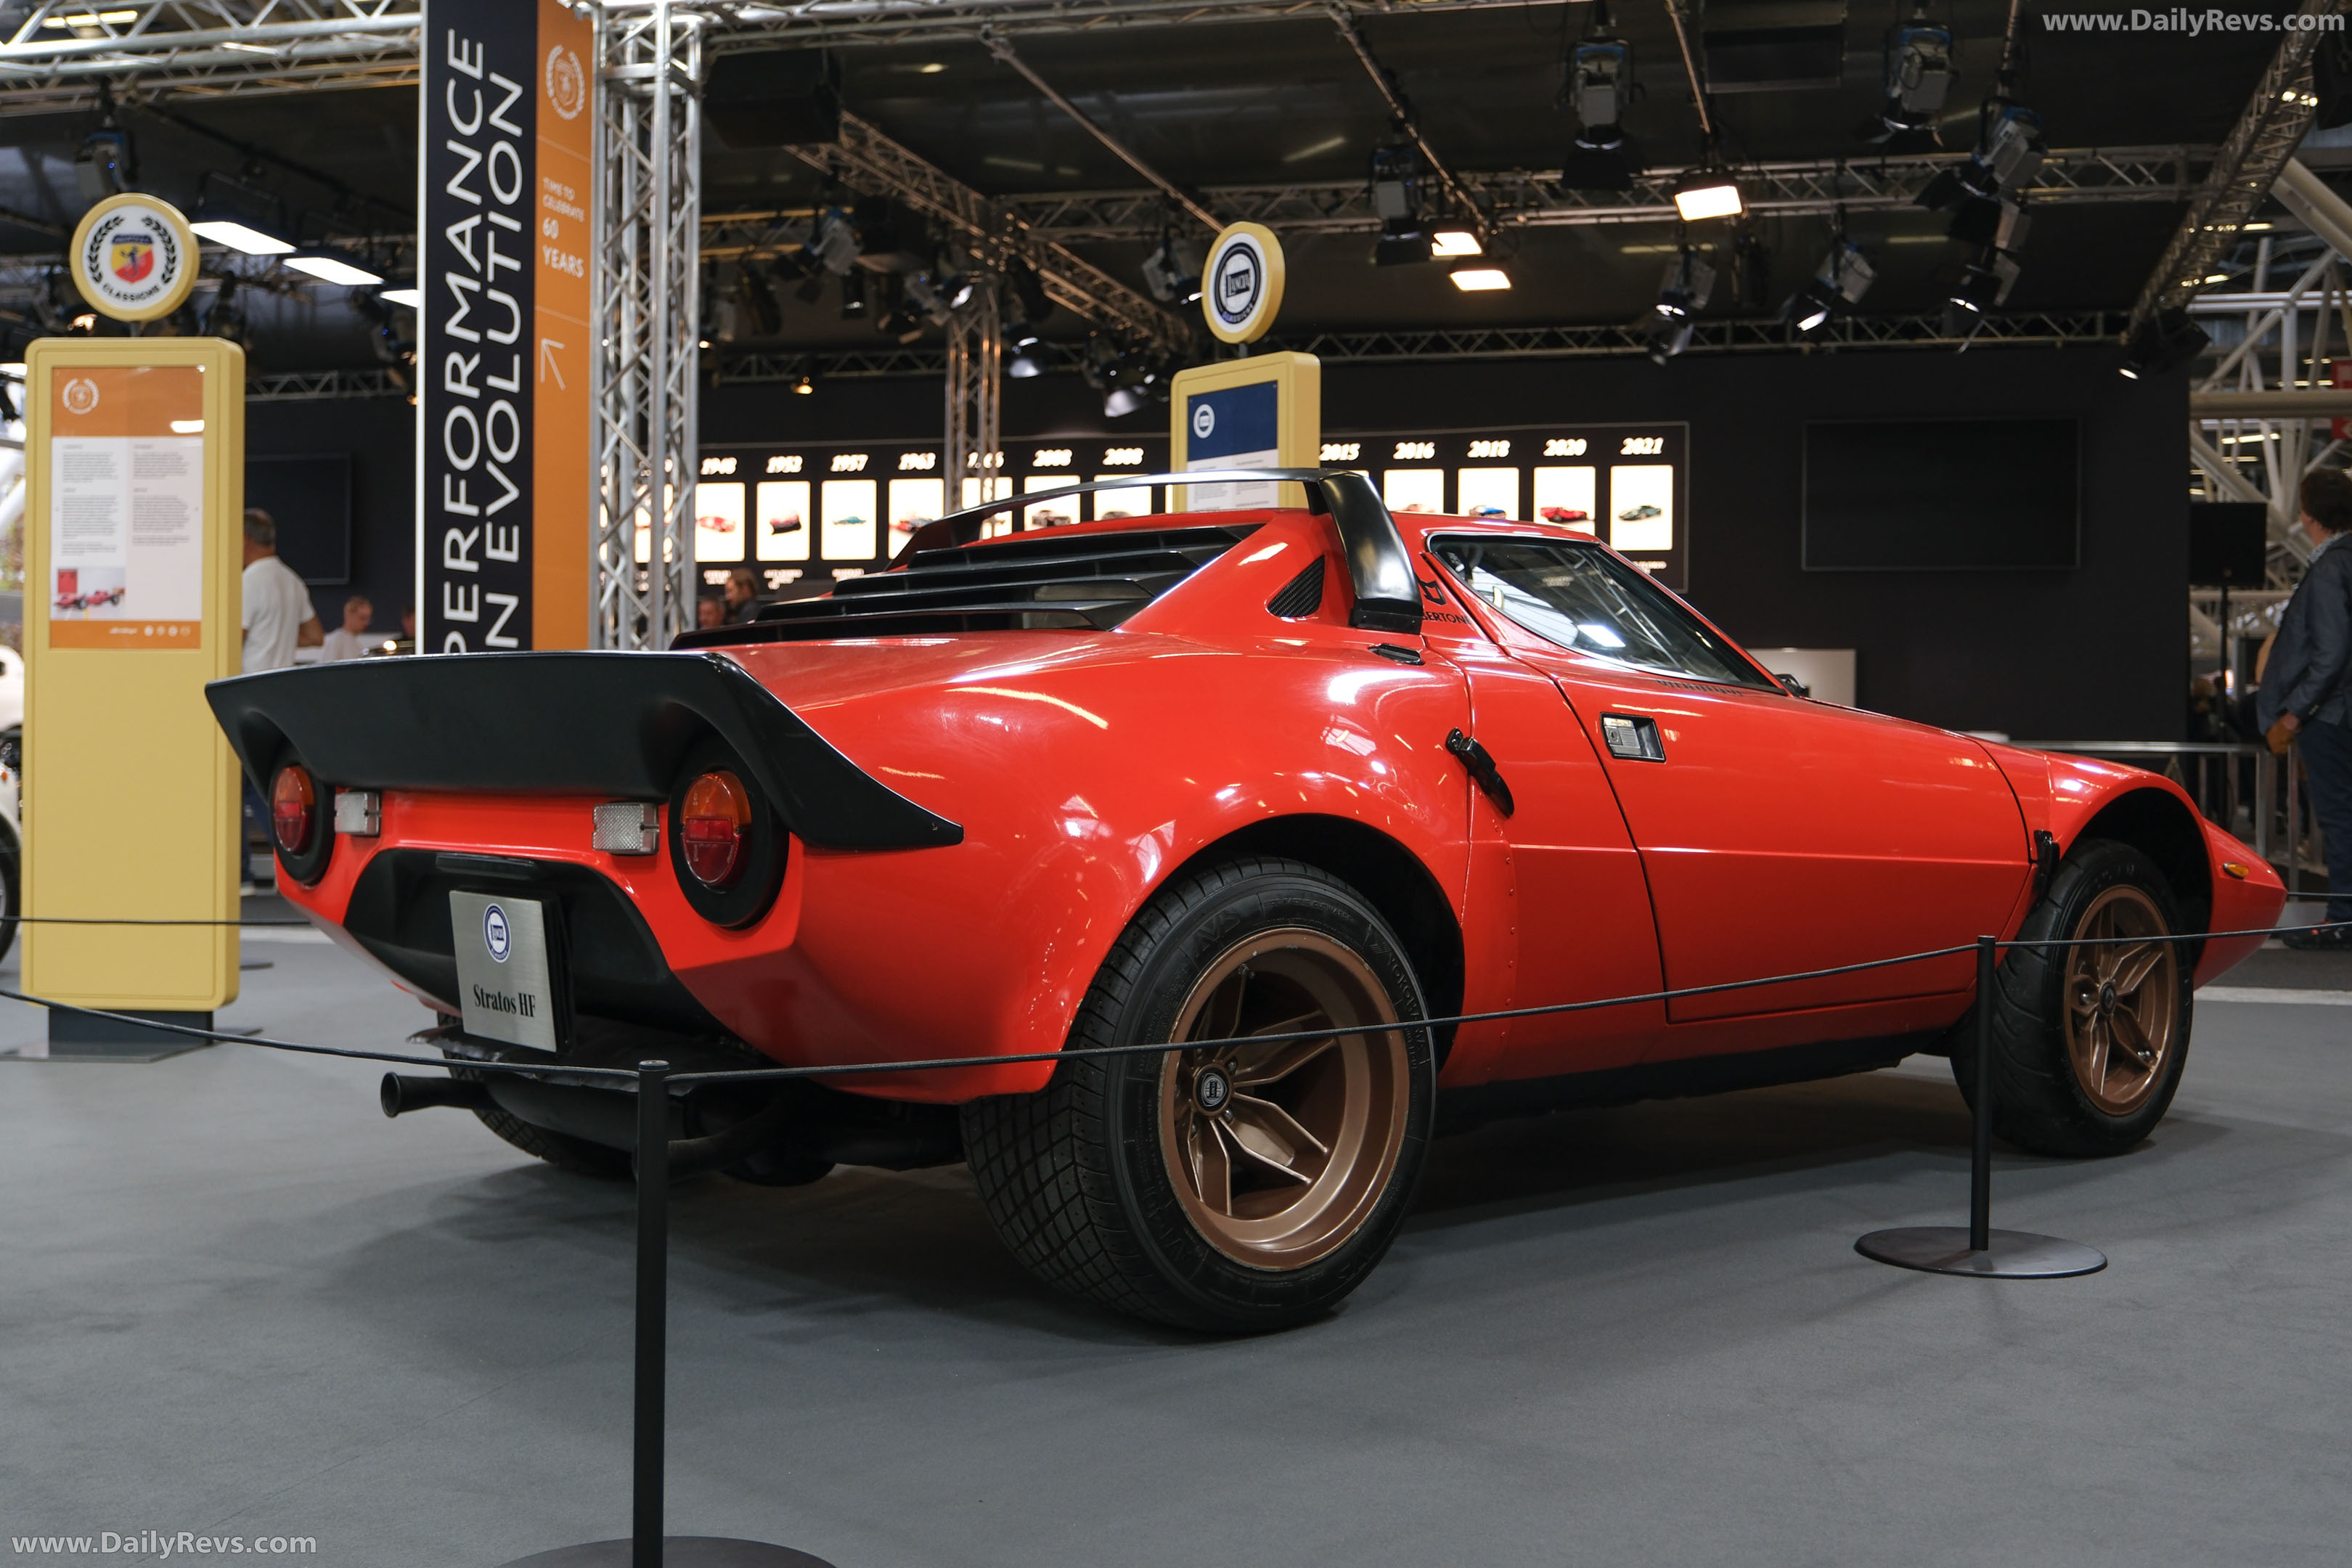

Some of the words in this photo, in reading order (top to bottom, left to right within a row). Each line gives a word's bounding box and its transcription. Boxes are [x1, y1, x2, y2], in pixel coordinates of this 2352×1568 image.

[543, 176, 563, 197] TIME
[563, 186, 576, 202] TO
[542, 194, 585, 223] CELEBRATE
[542, 217, 559, 240] 60
[542, 245, 584, 278] YEARS
[485, 71, 523, 563] EVOLUTION
[1318, 444, 1361, 461] 2015
[1392, 442, 1435, 460] 2016
[1466, 440, 1511, 457] 2018
[1543, 438, 1587, 457] 2020
[1620, 437, 1664, 455] 2021
[473, 983, 517, 1015] Stratos
[518, 992, 536, 1018] HF
